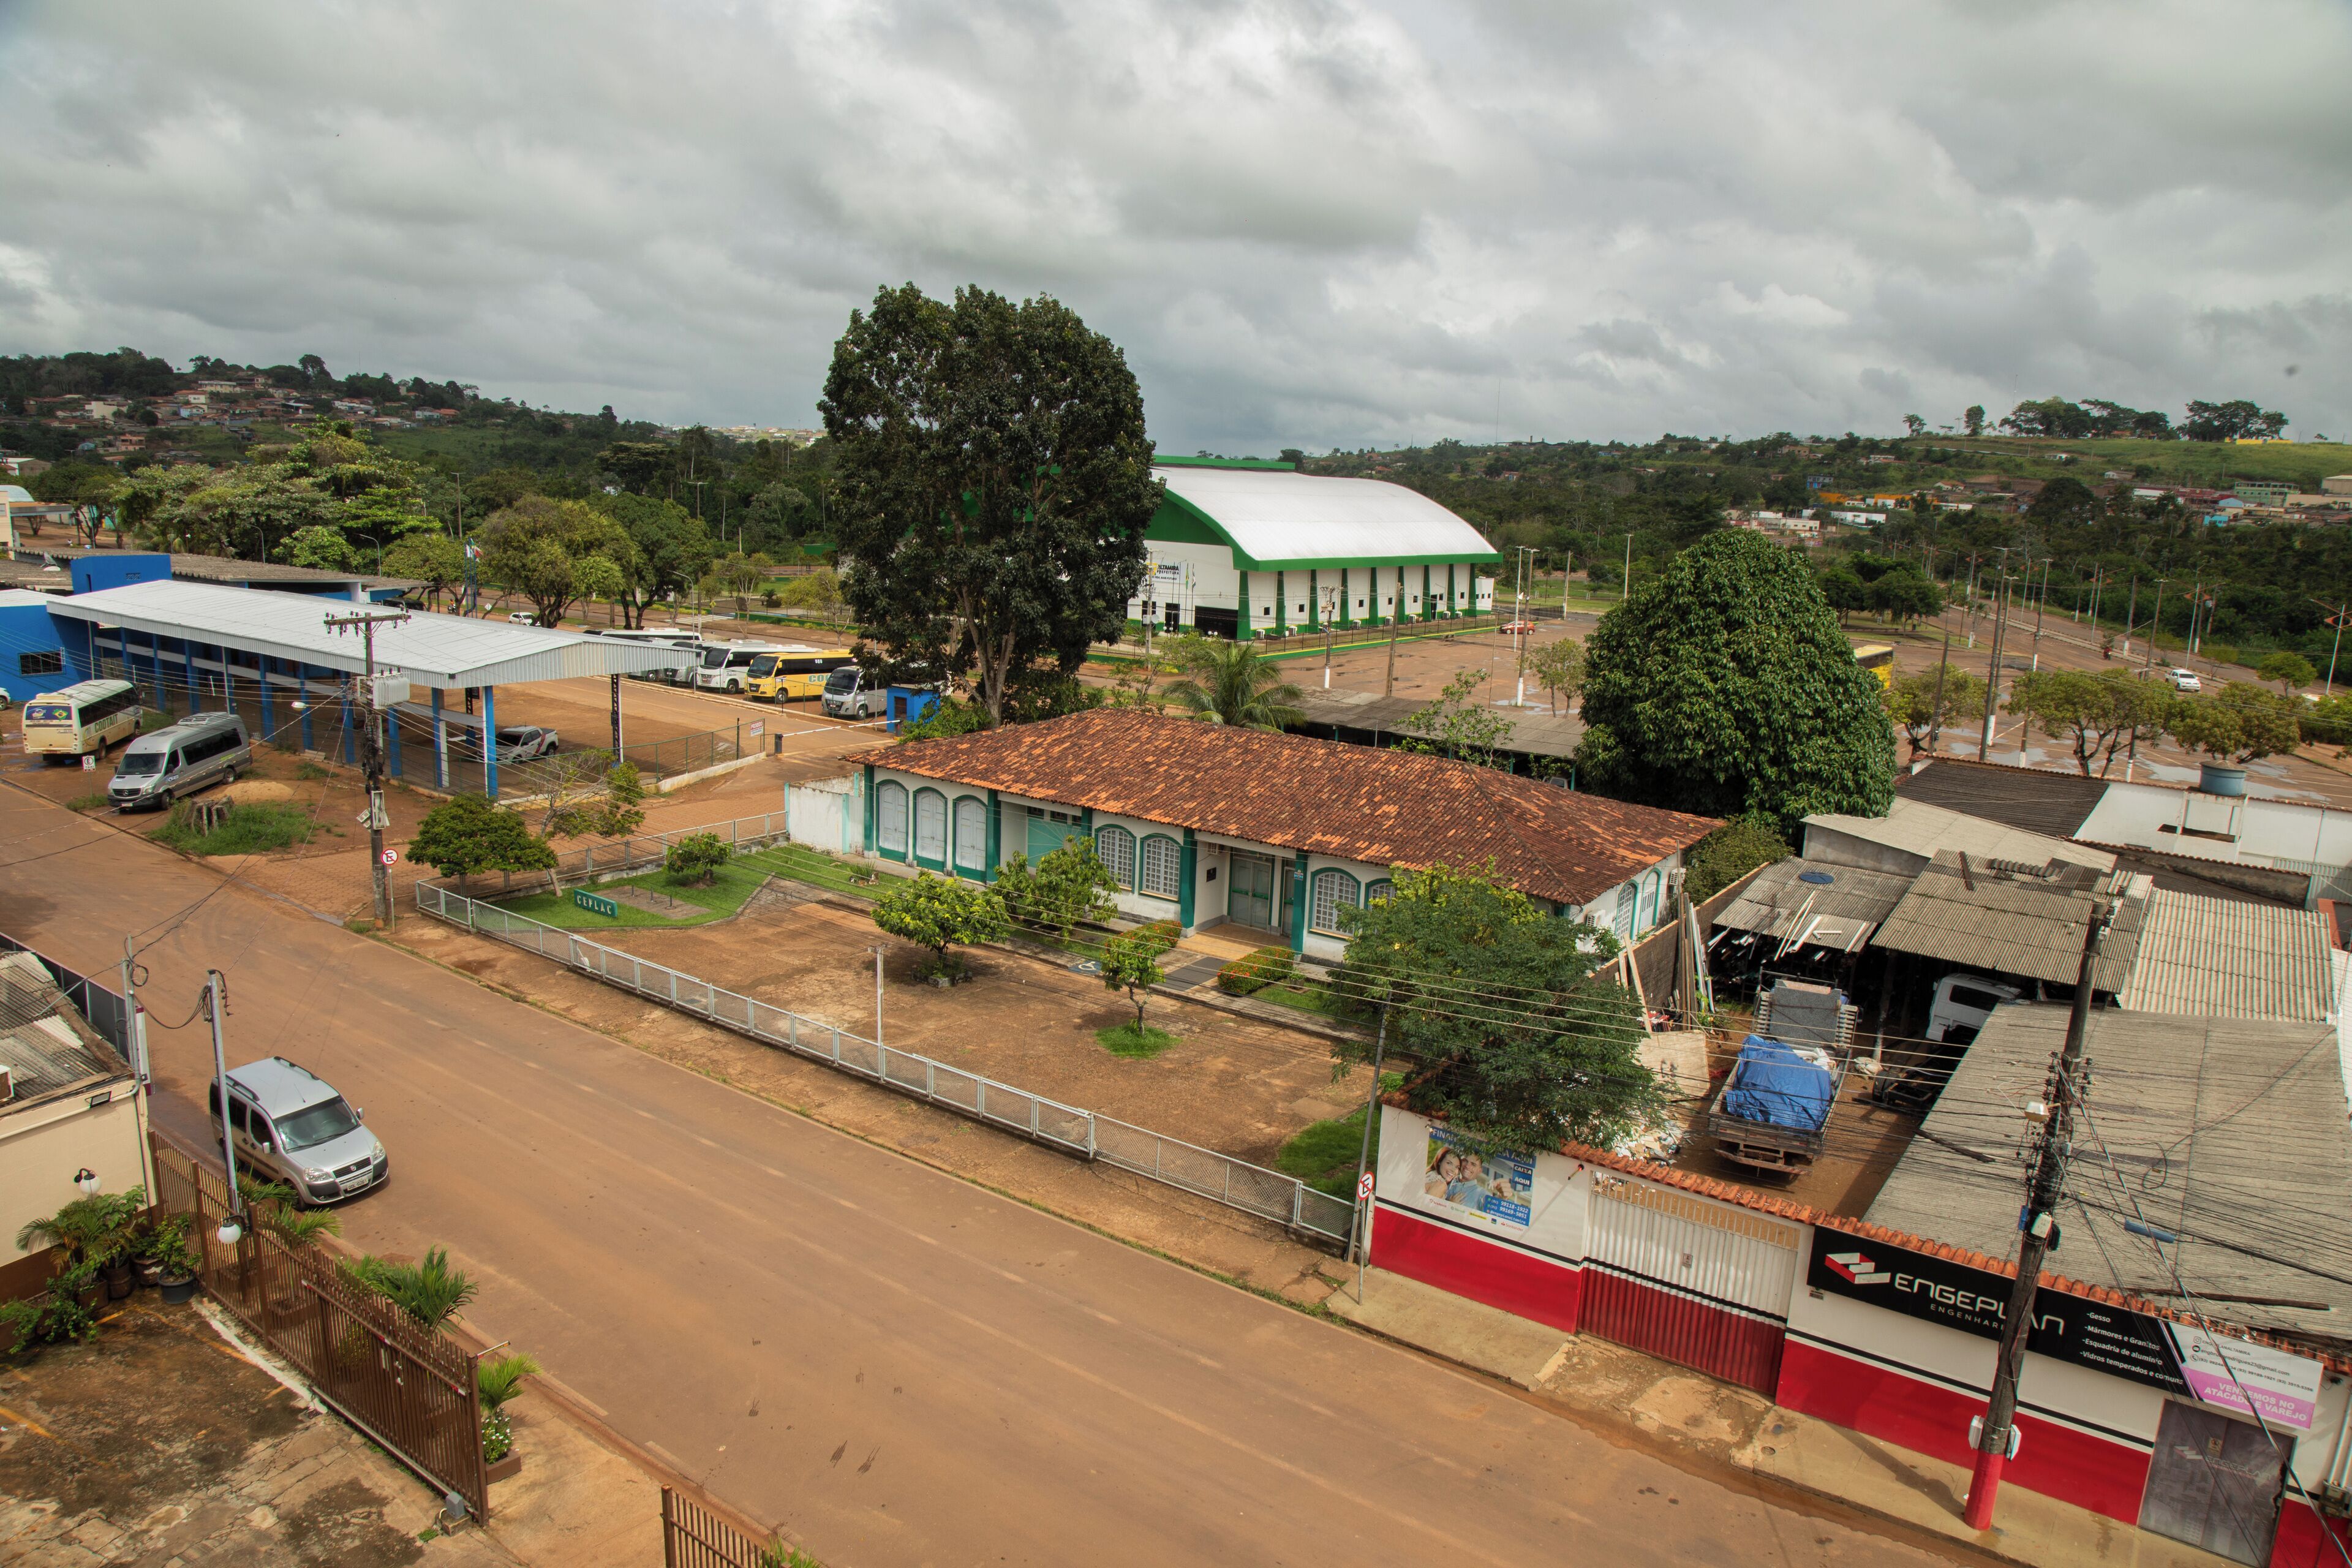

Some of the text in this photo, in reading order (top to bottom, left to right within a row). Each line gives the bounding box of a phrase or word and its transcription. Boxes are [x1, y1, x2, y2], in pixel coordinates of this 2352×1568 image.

[1514, 1166, 1532, 1175] CAIXA
[1514, 1177, 1530, 1185] AQUI
[1499, 1206, 1527, 1219] 99169-5051
[1501, 1200, 1529, 1213] 99118-1922
[1930, 1304, 2004, 1330] ENGENHARI
[2086, 1312, 2111, 1323] -Gesso
[2082, 1338, 2120, 1353] -Esquadria
[2080, 1351, 2106, 1363] -Vidros
[2106, 1357, 2148, 1376] temperados
[2155, 1373, 2184, 1385] comuns
[2218, 1382, 2294, 1410] VENEMOS NO
[2264, 1404, 2307, 1422] VAREJO
